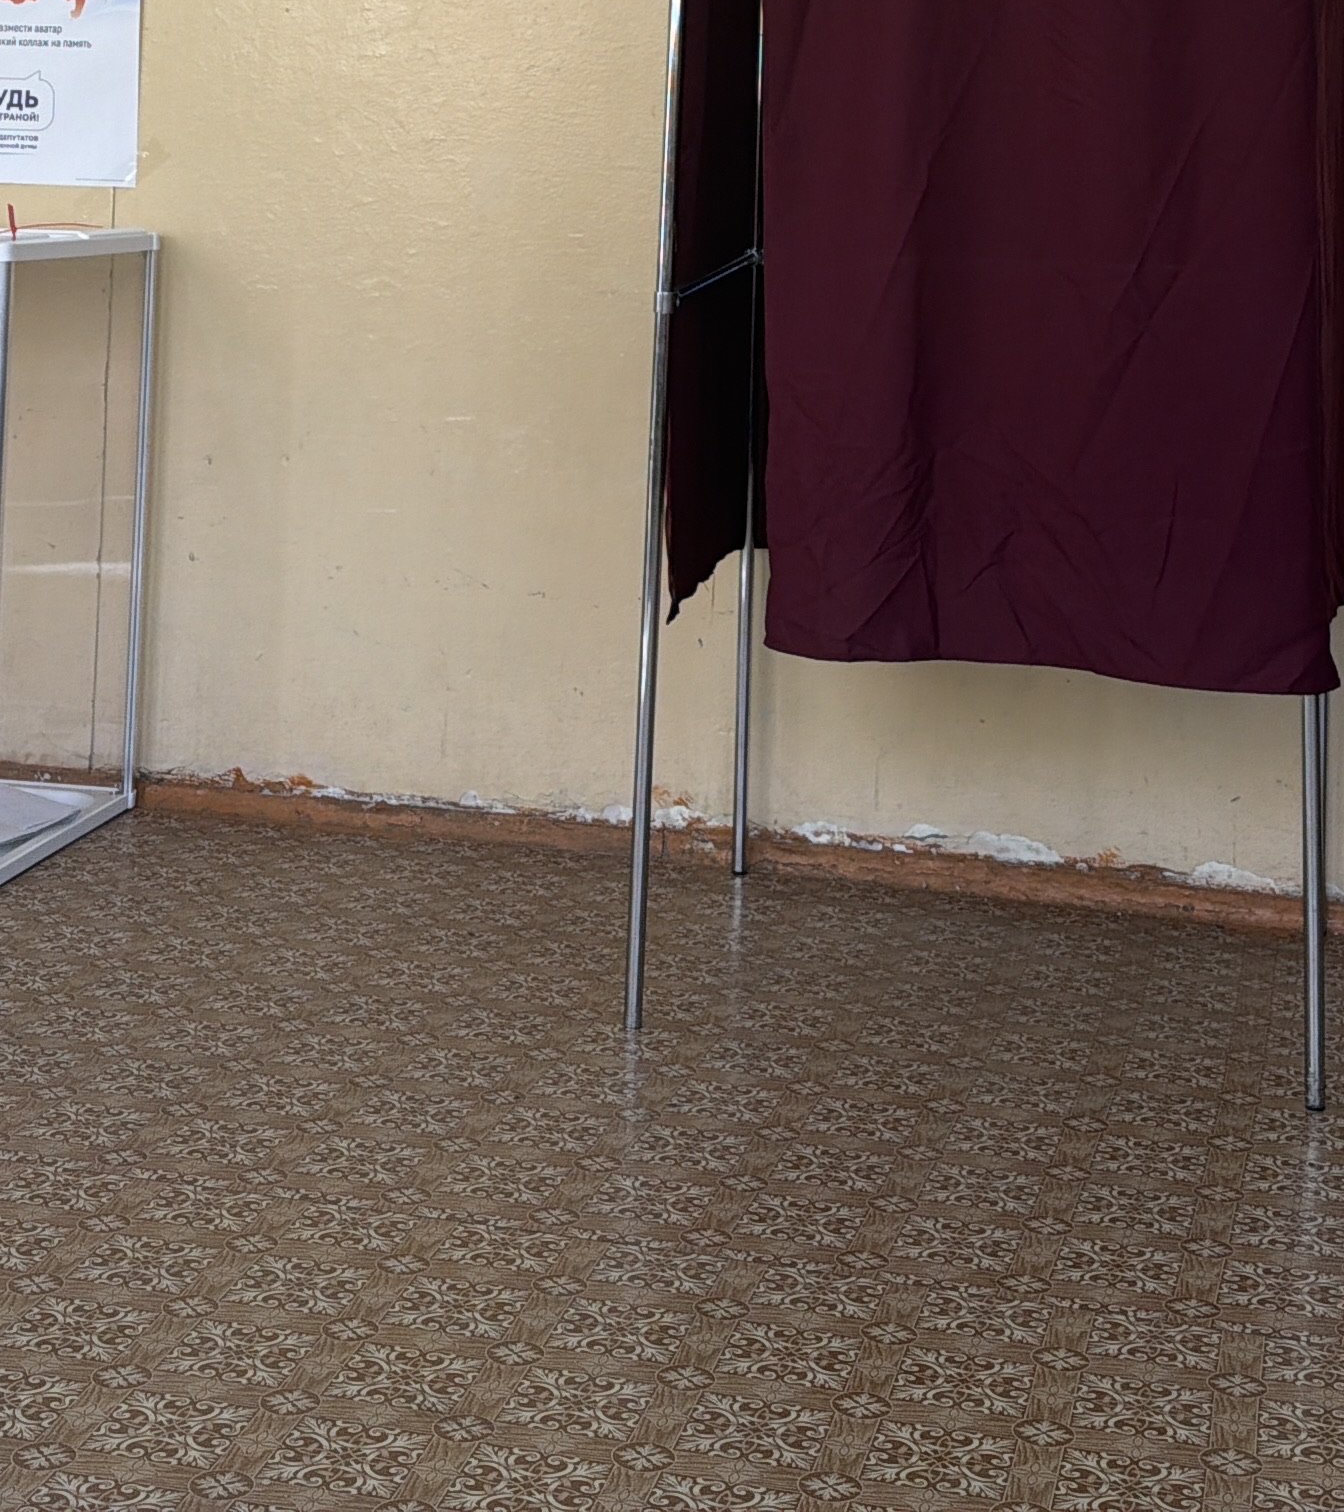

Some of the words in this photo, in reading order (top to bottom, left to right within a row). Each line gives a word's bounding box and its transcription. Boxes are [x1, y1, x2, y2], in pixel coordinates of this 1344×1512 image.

[34, 25, 63, 35] аватар
[18, 39, 49, 47] коллаж
[51, 40, 61, 48] на
[62, 39, 93, 49] память
